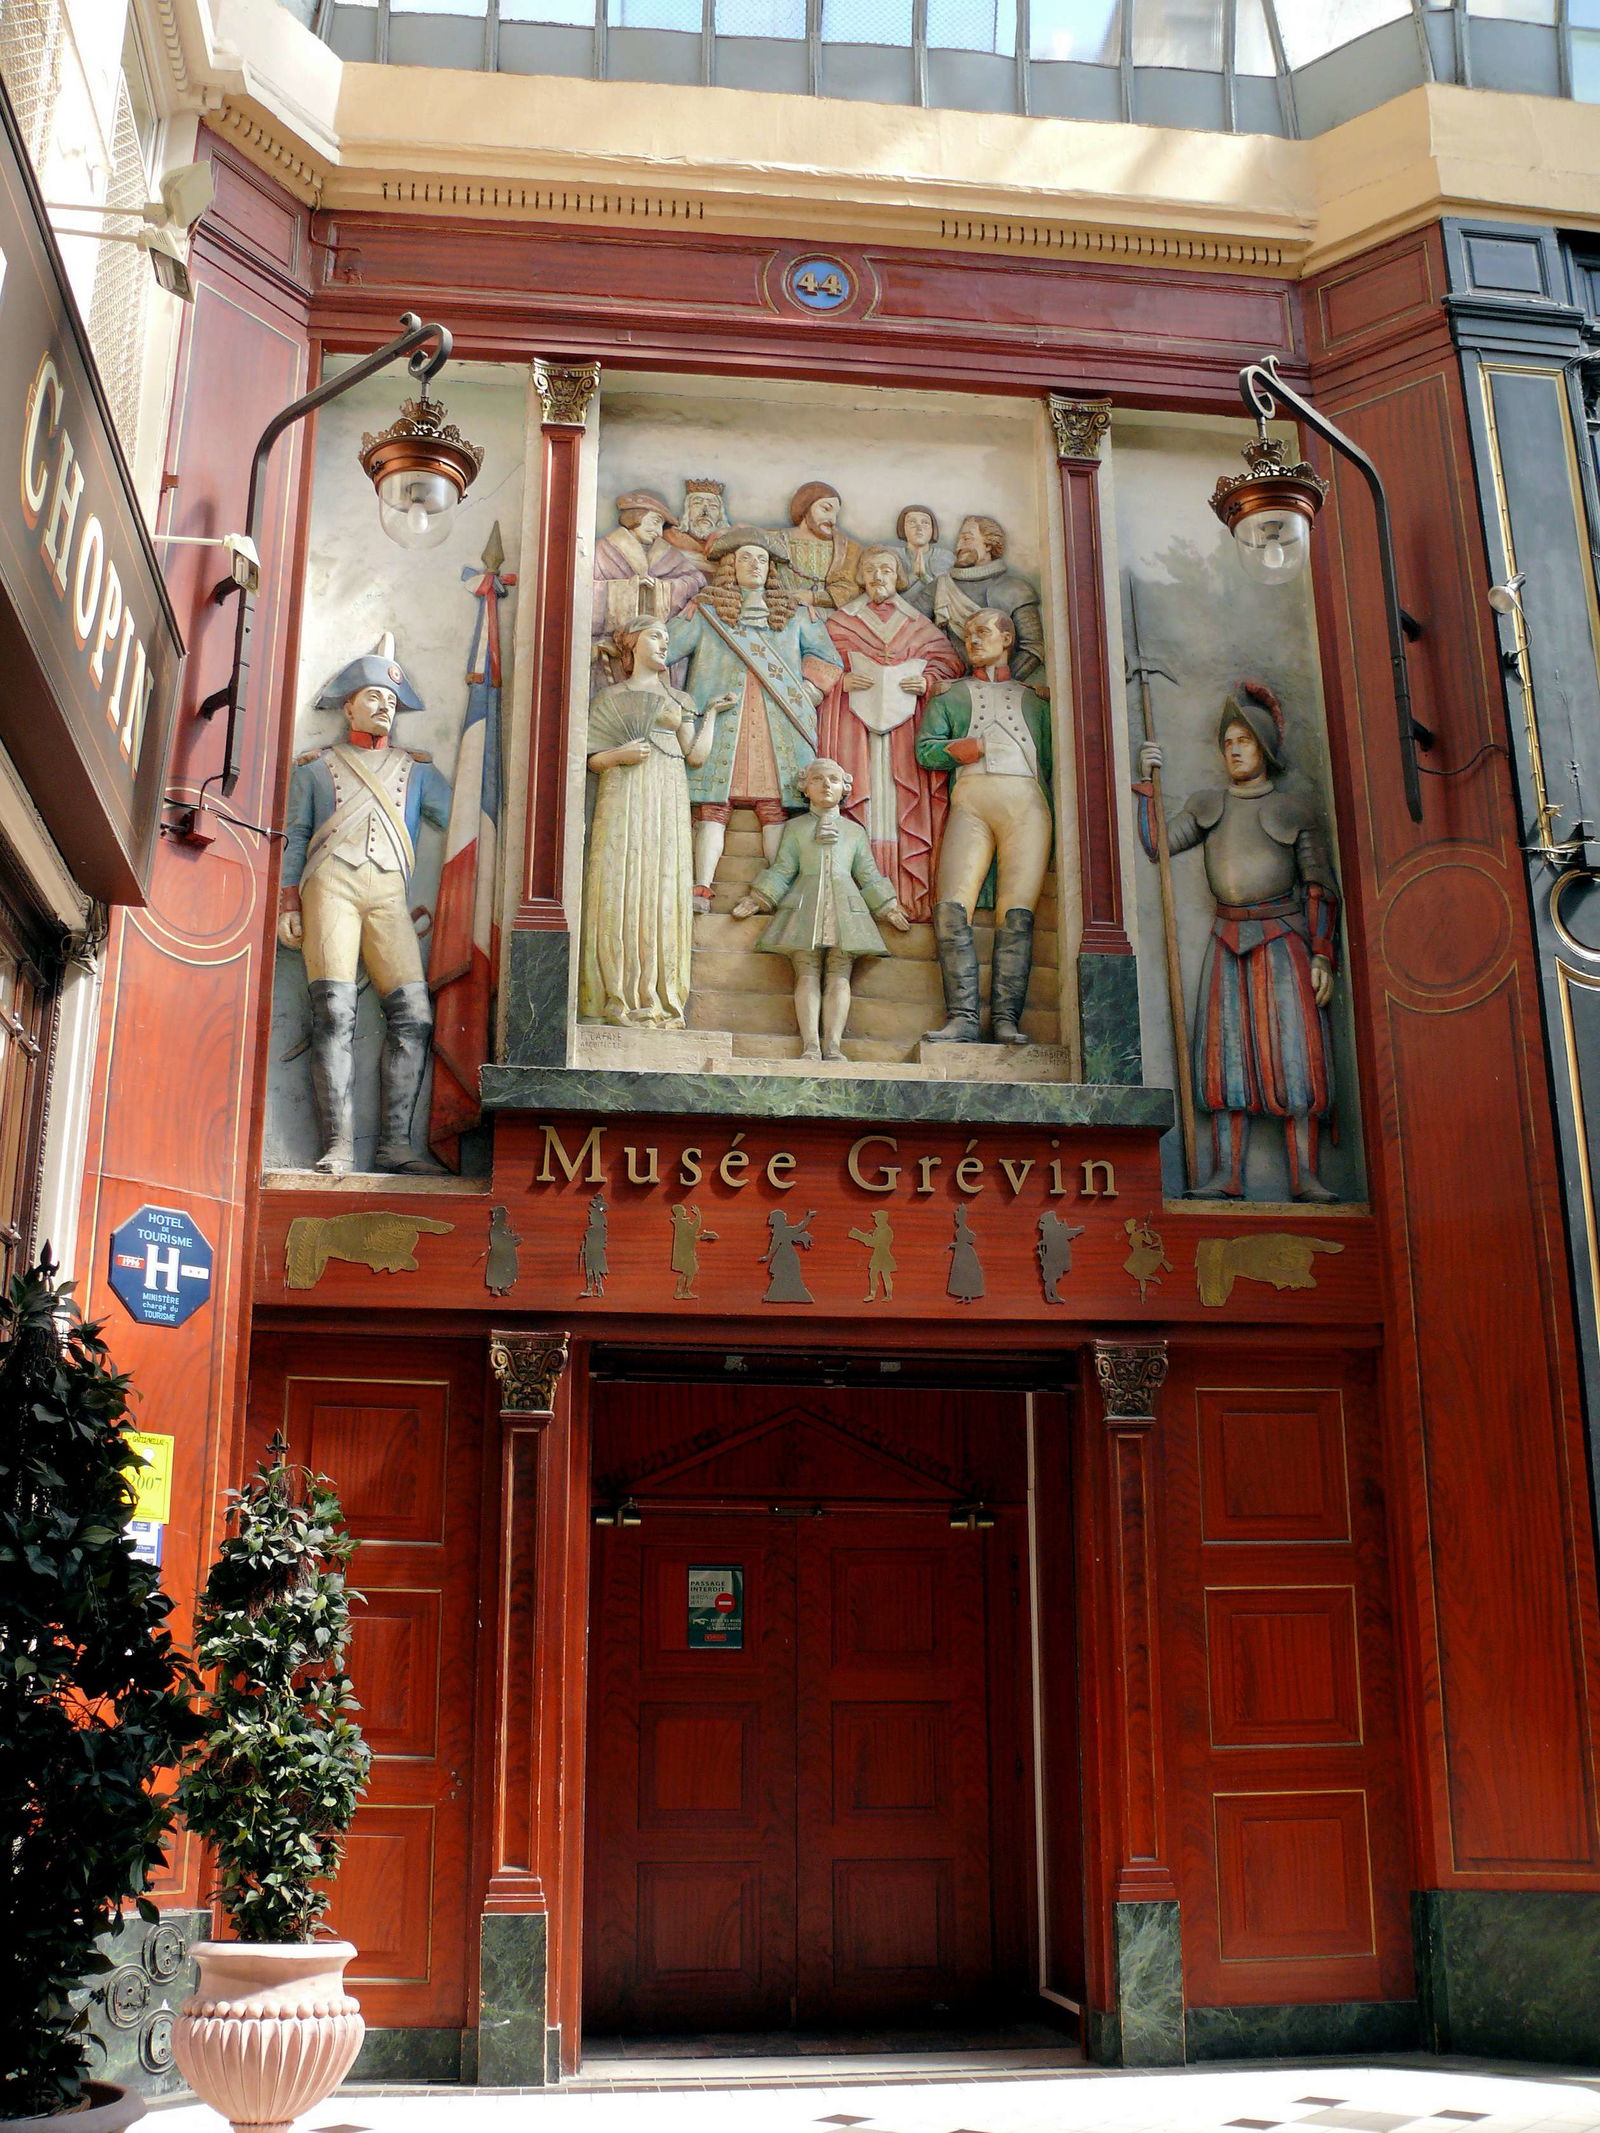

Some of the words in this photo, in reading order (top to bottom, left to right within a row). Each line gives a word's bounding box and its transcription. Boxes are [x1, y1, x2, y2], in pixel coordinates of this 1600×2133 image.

[797, 272, 842, 296] 44
[22, 350, 154, 778] CHOPIN
[535, 1124, 797, 1190] Musée
[848, 1135, 1118, 1196] Grévin
[148, 1213, 184, 1229] HOTEL
[138, 1228, 193, 1247] TOURISME
[143, 1243, 181, 1293] H
[142, 1292, 180, 1305] MINISTÈRE
[142, 1301, 167, 1312] chargé
[169, 1304, 179, 1313] du
[144, 1309, 176, 1322] TOURISME
